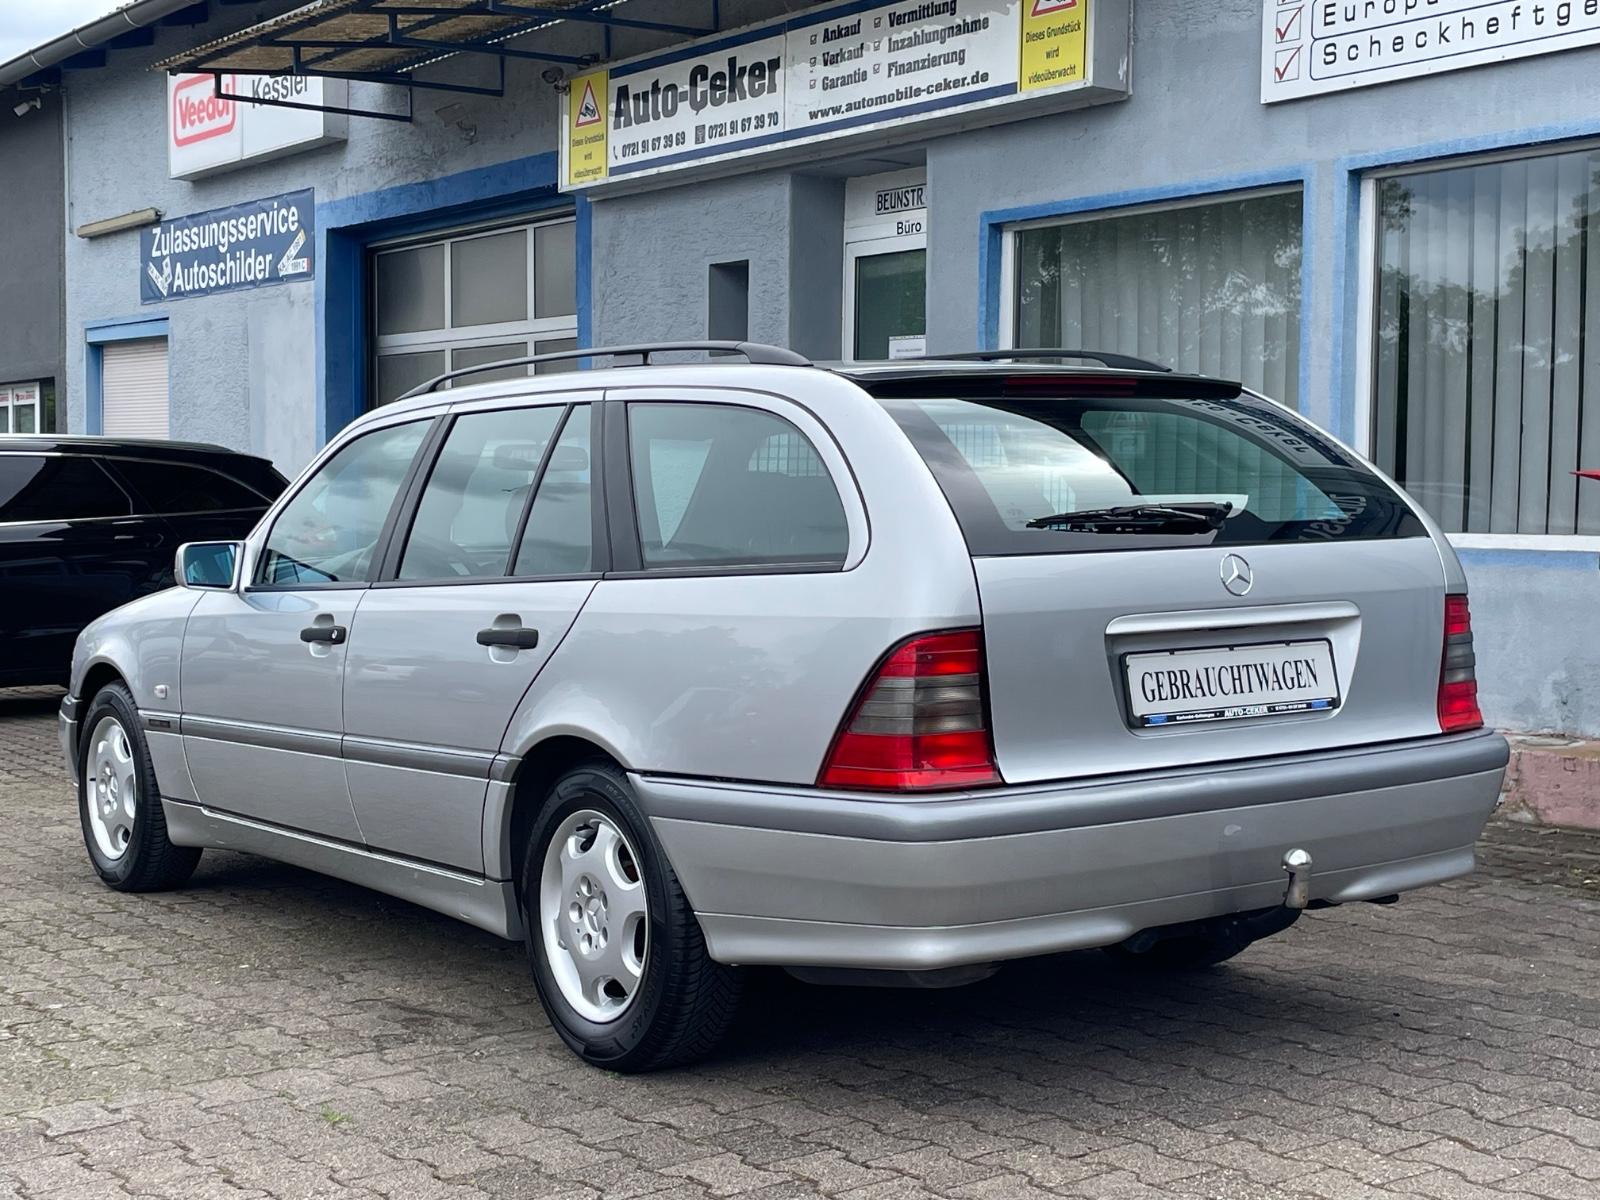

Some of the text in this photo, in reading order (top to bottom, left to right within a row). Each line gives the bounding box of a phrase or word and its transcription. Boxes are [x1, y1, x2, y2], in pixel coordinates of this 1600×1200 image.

[888, 0, 957, 27] Vermittlung
[1323, 0, 1439, 27] Europ
[822, 19, 862, 43] Ankauf
[887, 16, 990, 53] Inzahlungnahme
[1025, 20, 1082, 43] Dieses Grundstück
[822, 43, 864, 67] Verkauf
[887, 49, 966, 78] Finanzierung
[1045, 46, 1060, 60] wird
[822, 69, 868, 91] Garantie
[1028, 64, 1076, 84] videoüberwacht
[808, 71, 990, 120] www.automobile-ceker.de
[707, 111, 779, 140] 0721 91 67 39 70
[621, 131, 686, 157] 0721 91 67 39 69
[151, 202, 299, 258] Zulassungsservice
[896, 220, 922, 235] Büro
[173, 248, 273, 293] Autoschilder
[1141, 658, 1319, 703] GEBRAUCHTWAGEN
